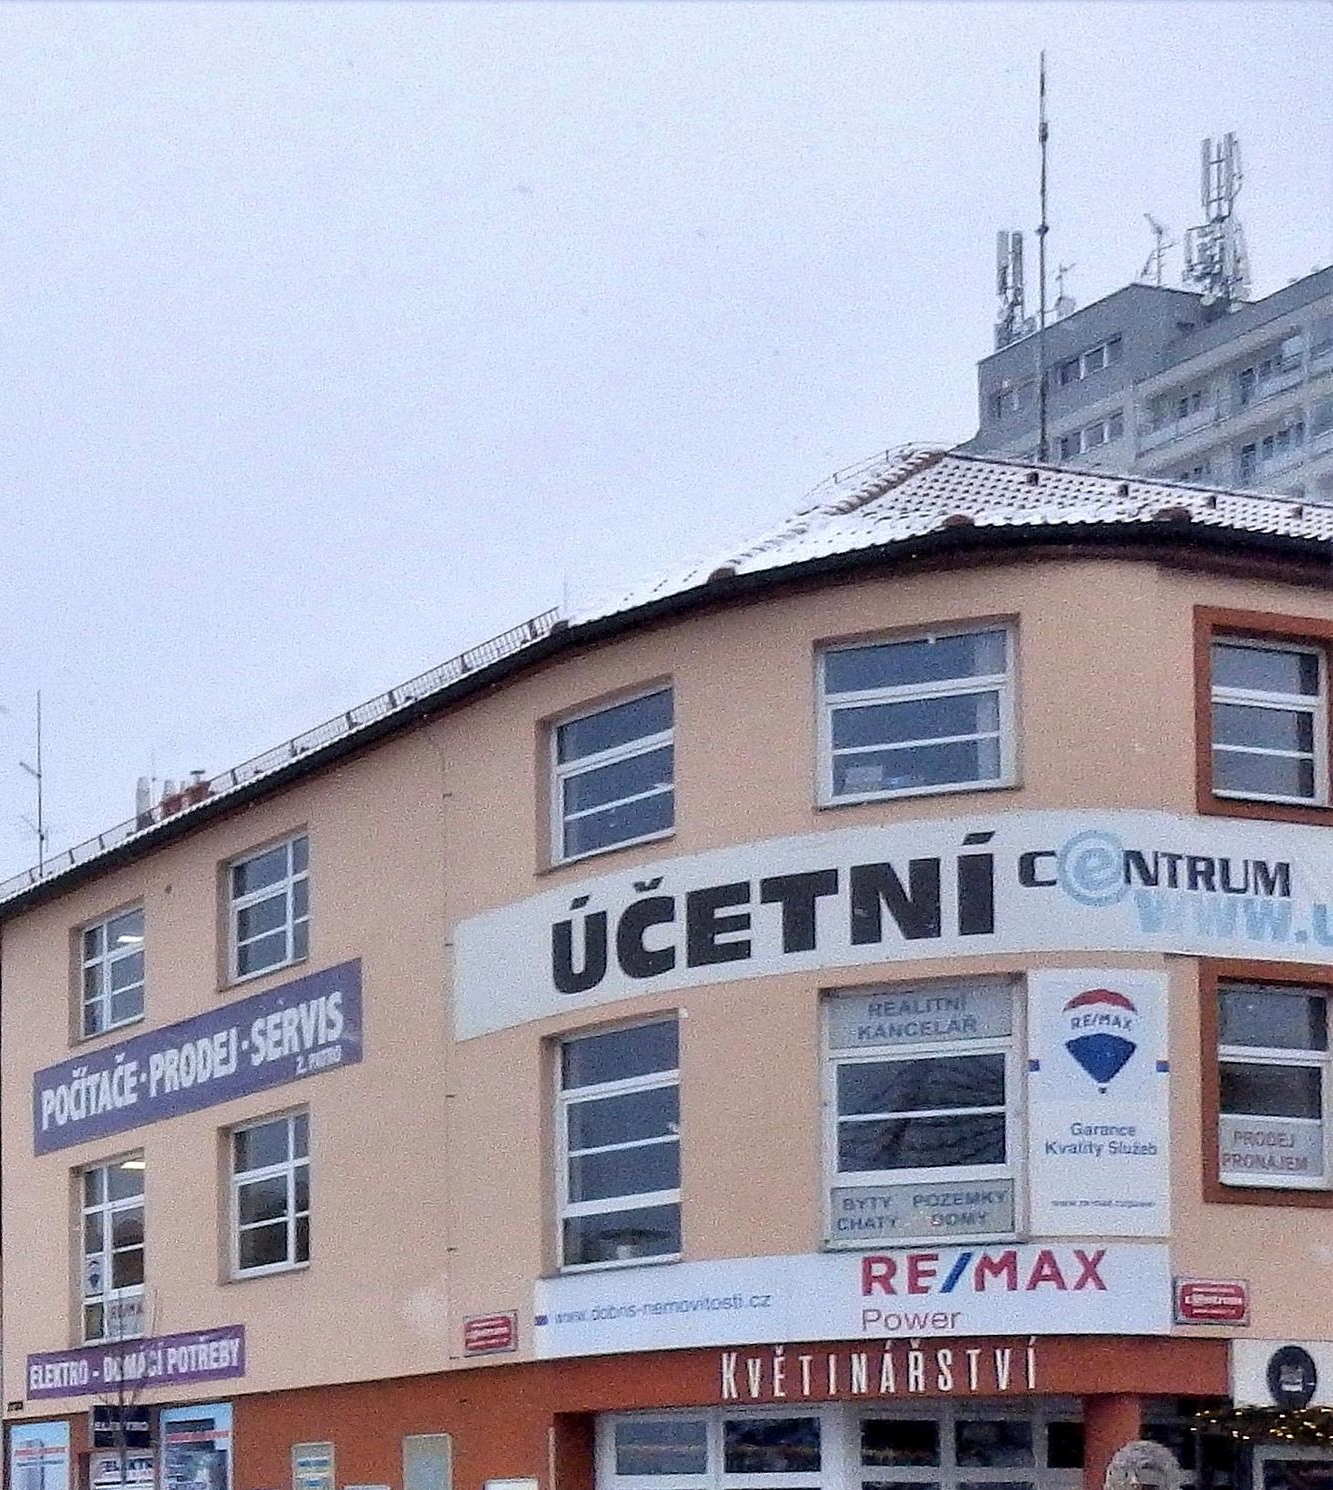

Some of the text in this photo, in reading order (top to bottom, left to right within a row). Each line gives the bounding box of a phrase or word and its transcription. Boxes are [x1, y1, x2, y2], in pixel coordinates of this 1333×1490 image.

[551, 830, 997, 995] ÚČETNÍ
[1071, 1013, 1132, 1031] RE/MAX
[41, 991, 344, 1131] POČÍTAČE PRODEJ SERVIS
[1071, 1122, 1137, 1137] Garance
[1234, 1130, 1295, 1149] PRODEJ
[1045, 1141, 1104, 1157] Kvality
[861, 1249, 1108, 1297] RE/MAX
[861, 1308, 962, 1332] Power
[29, 1359, 89, 1391] ELEKTRO
[166, 1335, 241, 1377] POTŘEBY
[720, 1336, 1037, 1400] KVĚTINÁŘSTVÍ
